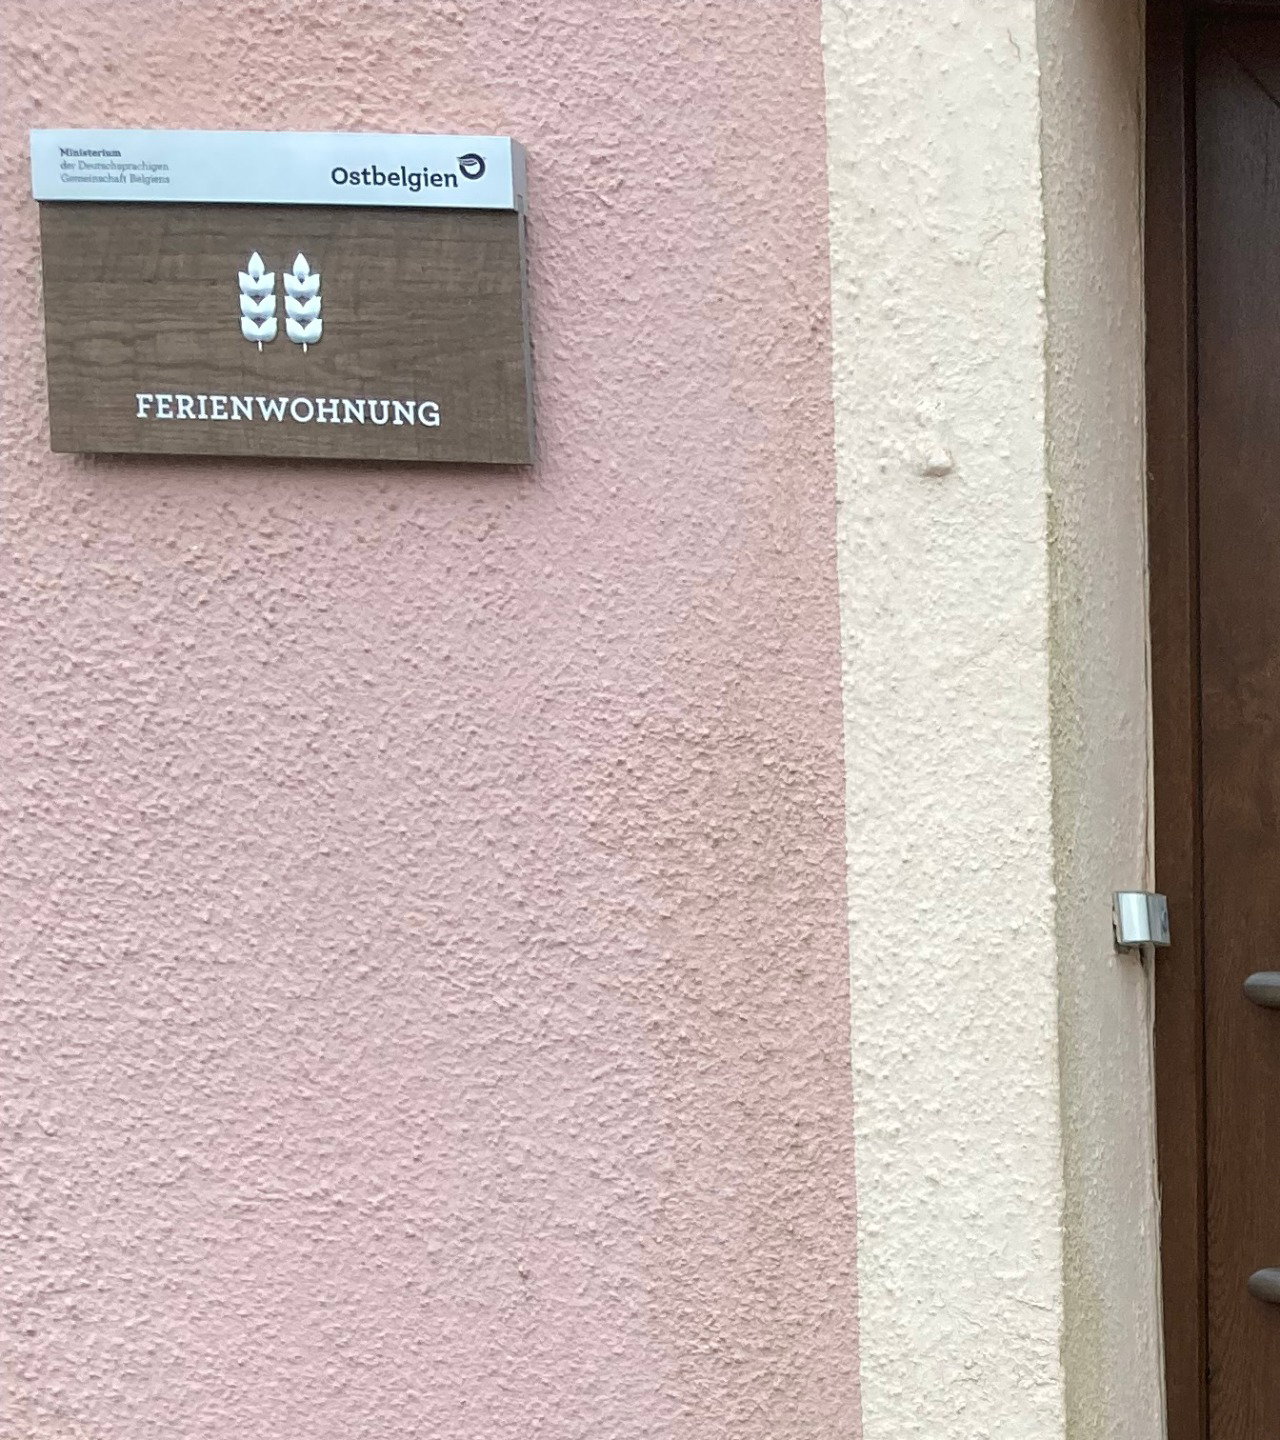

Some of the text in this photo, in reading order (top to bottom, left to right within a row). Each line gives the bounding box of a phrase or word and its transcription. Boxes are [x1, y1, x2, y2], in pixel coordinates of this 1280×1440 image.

[59, 147, 122, 158] Ministerium
[60, 160, 75, 170] der
[331, 165, 458, 192] Ostbelgien
[135, 393, 441, 427] FERIENWOHNUNG
